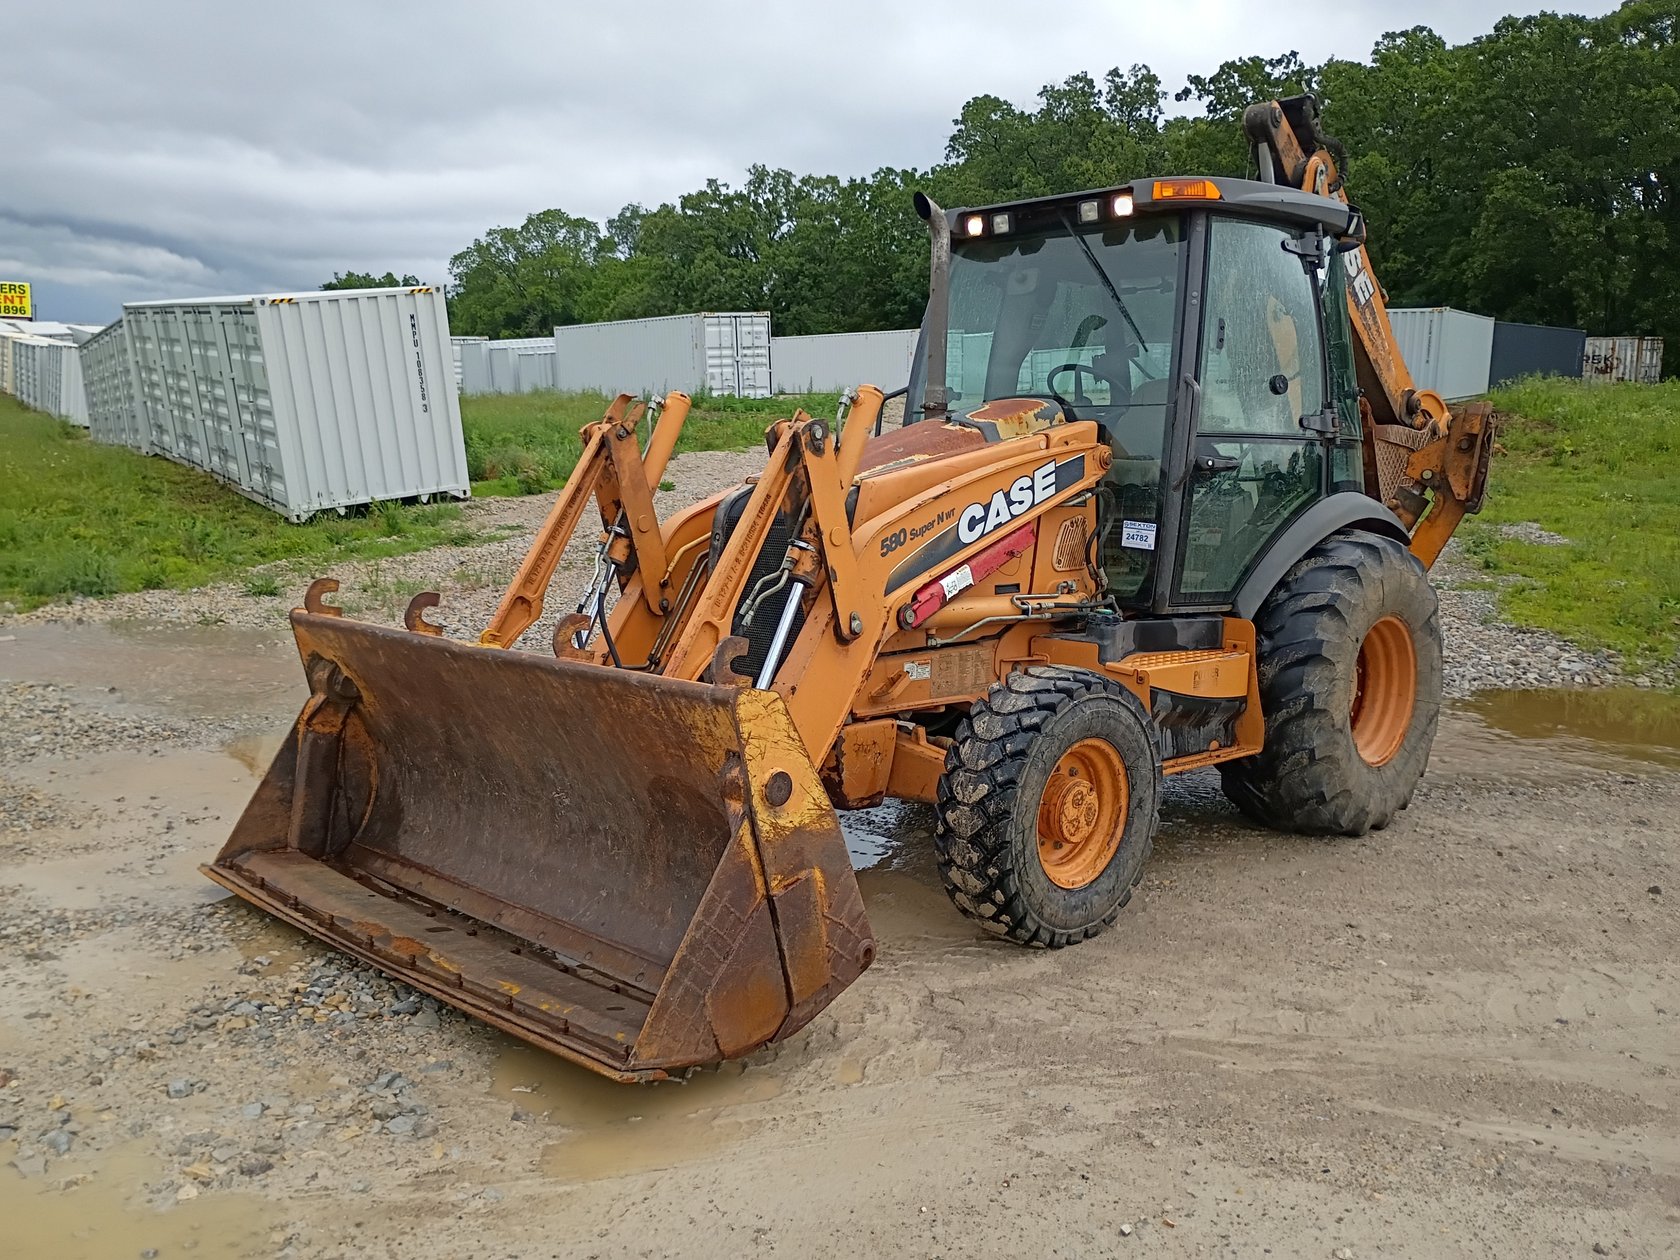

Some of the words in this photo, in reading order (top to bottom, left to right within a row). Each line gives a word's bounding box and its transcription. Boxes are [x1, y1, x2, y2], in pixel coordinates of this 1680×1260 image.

[0, 283, 26, 295] ERS
[0, 295, 26, 305] NT
[410, 313, 418, 348] MMPU
[958, 458, 1056, 544] CASE
[880, 527, 908, 558] 580
[909, 518, 936, 541] Super
[936, 511, 945, 525] N
[945, 507, 956, 520] WT
[1126, 533, 1149, 543] 24782
